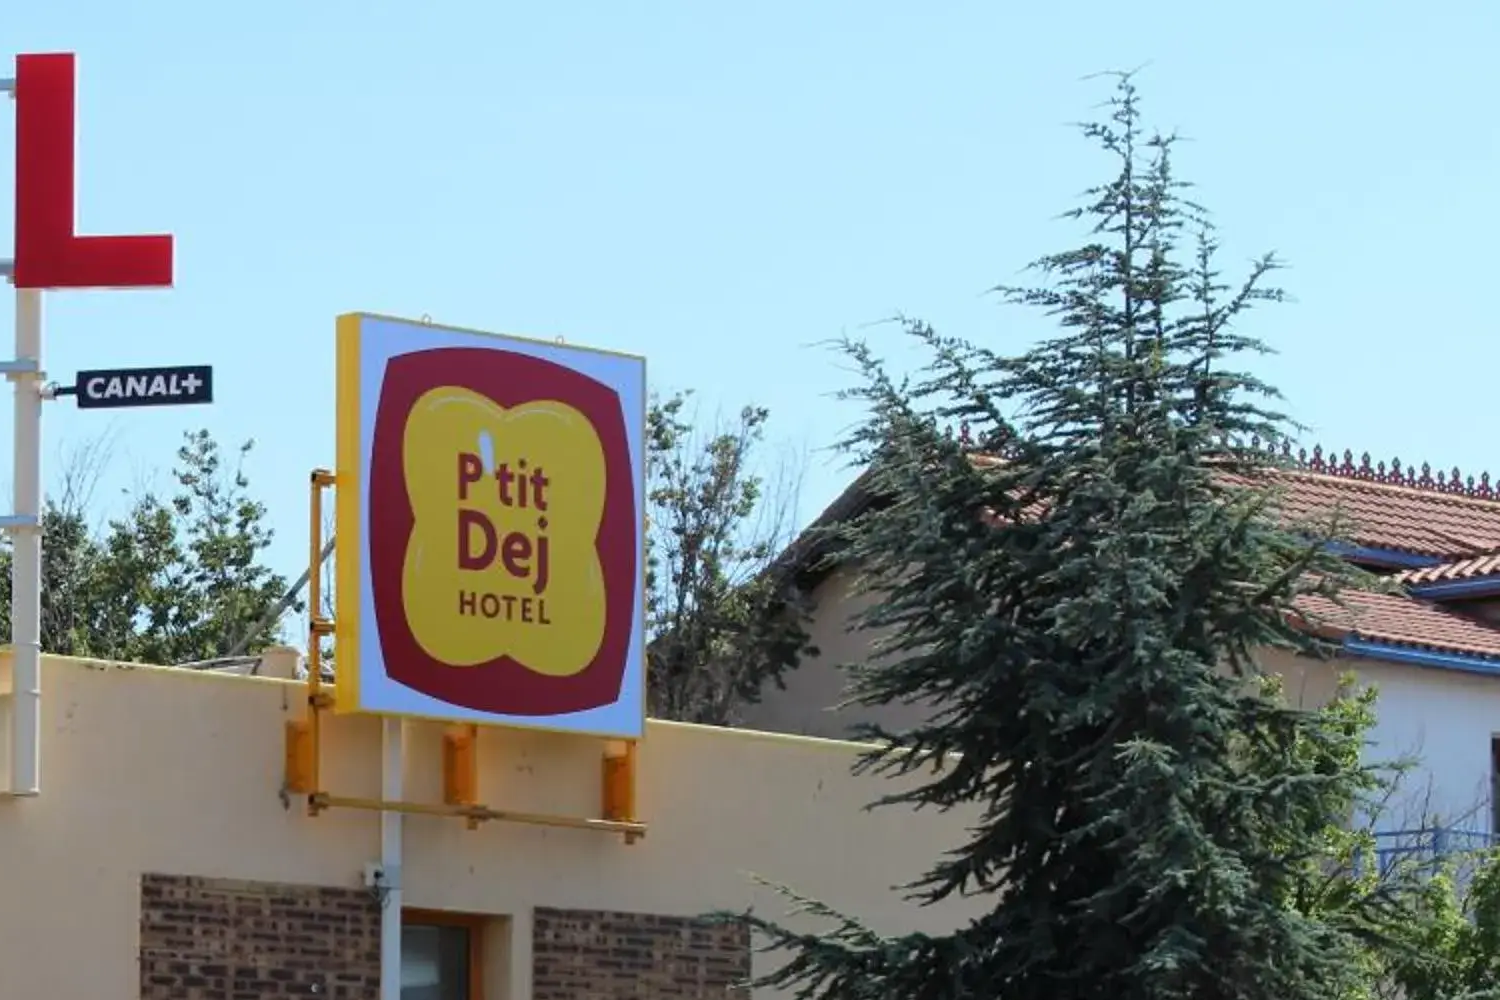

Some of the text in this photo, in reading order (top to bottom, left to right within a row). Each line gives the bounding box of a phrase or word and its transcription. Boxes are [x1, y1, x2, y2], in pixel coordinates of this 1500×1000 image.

[87, 373, 203, 399] CANAL+
[458, 509, 548, 595] Dej
[459, 590, 551, 625] HOTEL
